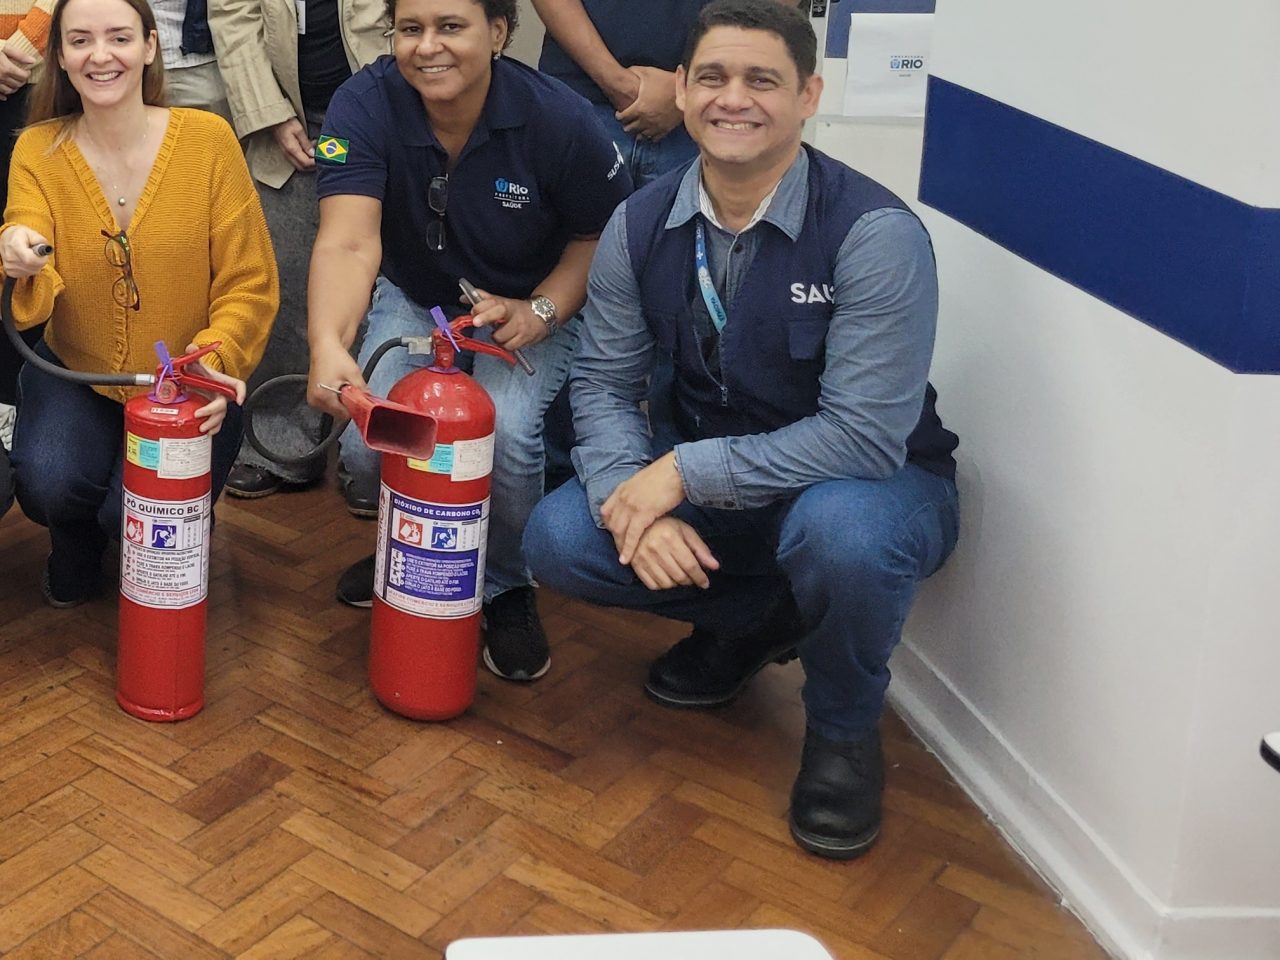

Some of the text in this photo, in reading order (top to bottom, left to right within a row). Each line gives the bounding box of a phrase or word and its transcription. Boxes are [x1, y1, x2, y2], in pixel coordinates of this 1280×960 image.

[900, 59, 924, 69] RIO
[508, 182, 529, 195] Rio
[126, 497, 200, 516] PÓ QUÍMICO BC
[394, 498, 423, 513] DIÓXIDO
[435, 509, 471, 517] CARBONO
